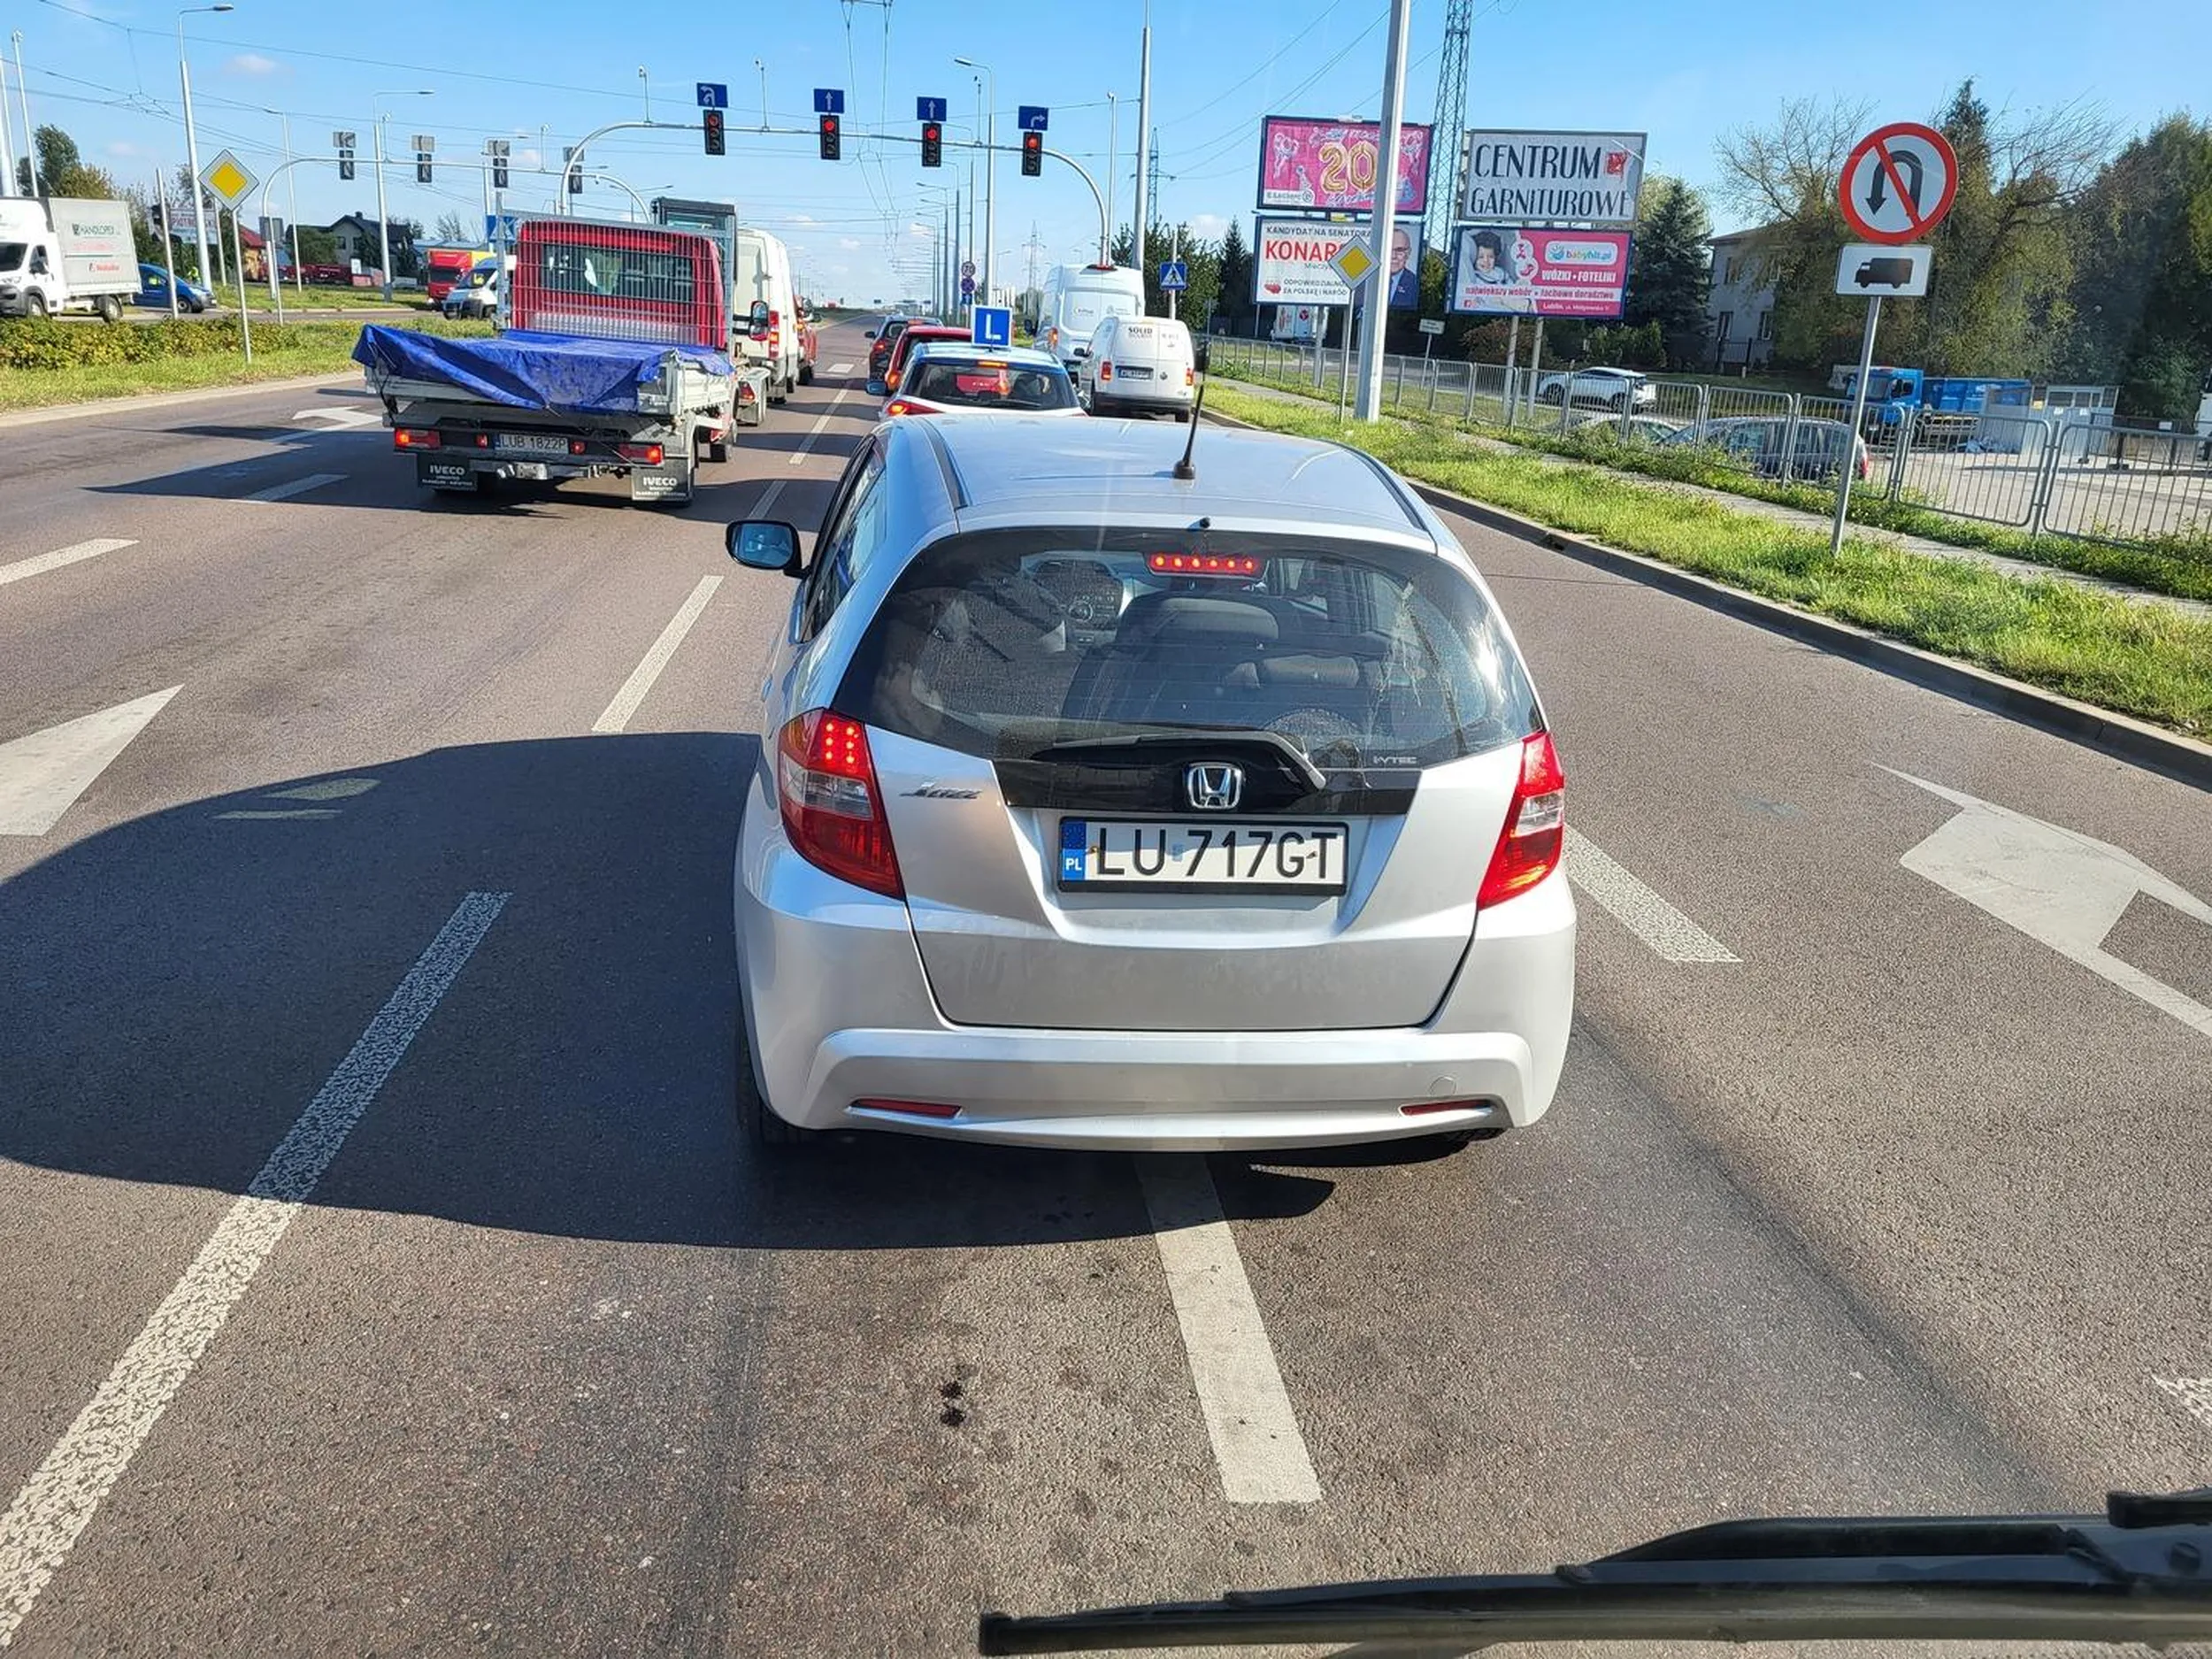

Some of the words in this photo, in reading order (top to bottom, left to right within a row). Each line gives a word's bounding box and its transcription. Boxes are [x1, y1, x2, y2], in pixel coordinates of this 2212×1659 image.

[1475, 143, 1601, 180] CENTRUM
[1471, 187, 1631, 218] GARNITUROWE
[1266, 226, 1311, 235] KANDYDAT
[1314, 227, 1325, 236] NA
[1265, 240, 1342, 262] KONAR
[1284, 278, 1344, 287] ODPOWIEDZIALNO
[1542, 269, 1572, 281] WÓZKI
[1578, 271, 1617, 283] FOTELIKI
[985, 314, 1002, 340] L
[502, 434, 524, 447] LUB
[530, 437, 566, 450] 1822P
[430, 465, 465, 476] IVECO
[643, 476, 678, 487] IVECO
[1097, 828, 1166, 876] LU
[1185, 829, 1339, 879] 717GT
[1065, 858, 1082, 872] PL
